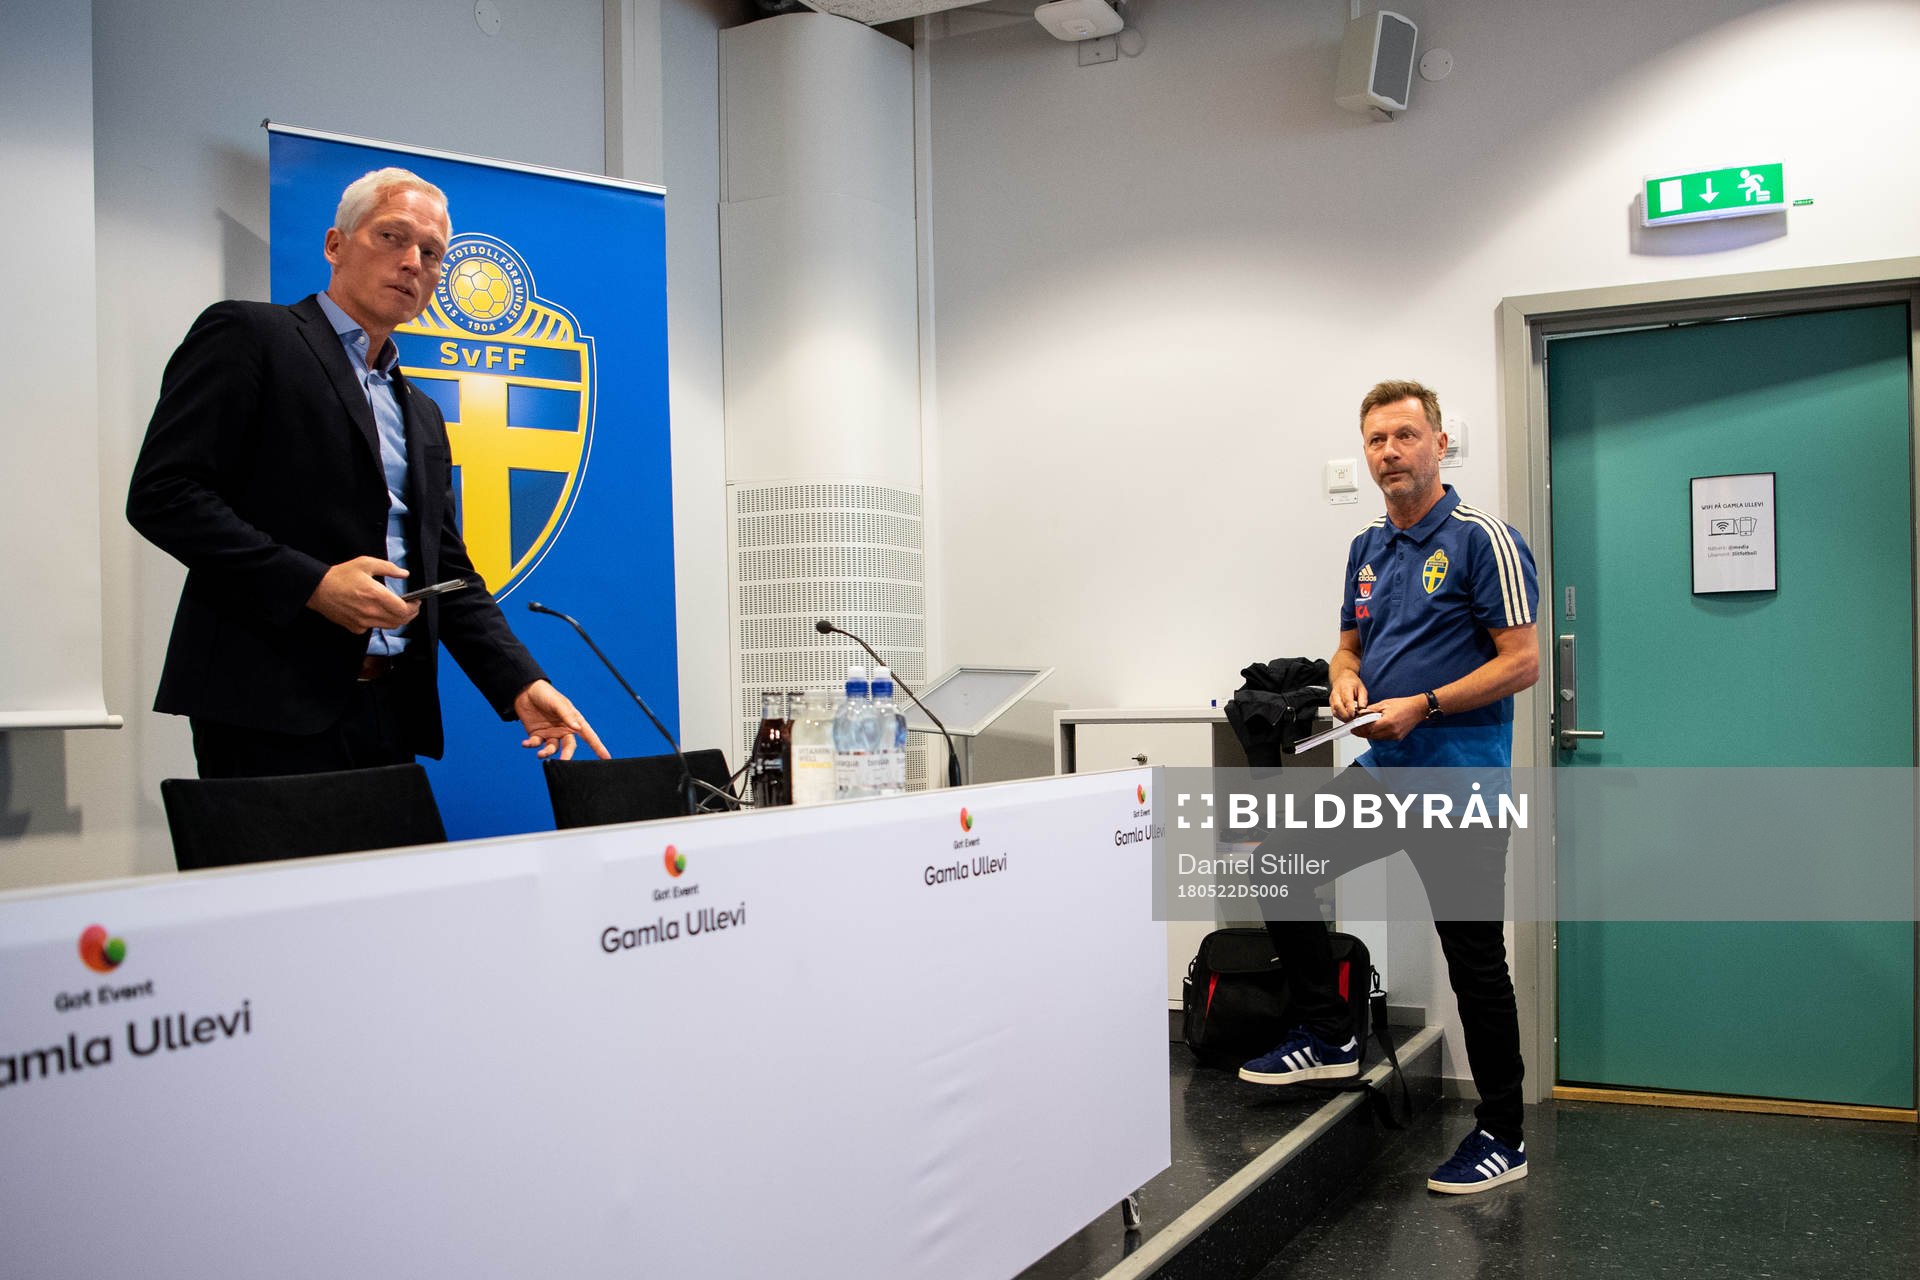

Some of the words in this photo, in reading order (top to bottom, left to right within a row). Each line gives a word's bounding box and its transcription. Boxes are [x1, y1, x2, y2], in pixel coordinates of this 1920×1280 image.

[437, 262, 458, 318] SVENSKA
[449, 245, 524, 325] FOTBOLLFÖRBUNDET
[468, 320, 496, 332] 1904
[440, 341, 527, 371] SvFF
[1115, 827, 1143, 846] Gamla
[1145, 823, 1166, 840] Ullevi
[924, 861, 968, 886] Gamla
[972, 852, 1007, 876] Ullevi
[653, 888, 670, 901] Got
[673, 884, 699, 899] Event
[601, 917, 679, 953] Gamla
[686, 901, 746, 936] Ullevi
[54, 989, 91, 1012] Got
[97, 979, 154, 1004] Event
[0, 1032, 113, 1088] amla
[127, 998, 253, 1057] Ullevi
